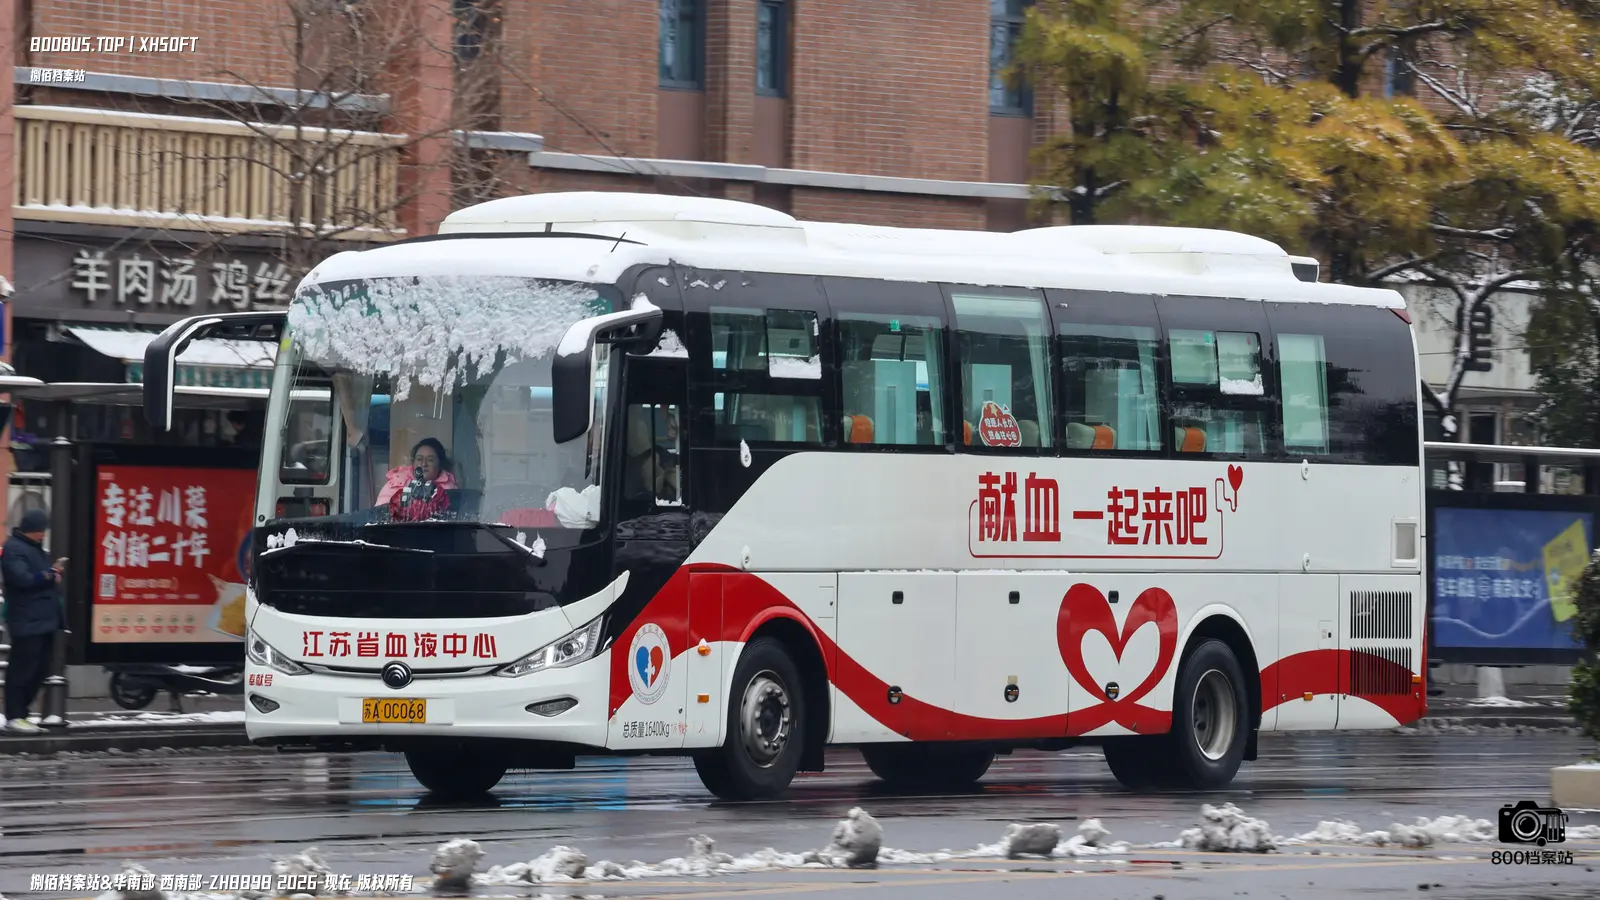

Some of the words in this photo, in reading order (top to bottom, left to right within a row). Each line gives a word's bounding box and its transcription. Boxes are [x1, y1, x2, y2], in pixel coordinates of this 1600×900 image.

[72, 249, 198, 306] 羊肉汤
[211, 259, 292, 311] 鸡丝
[102, 482, 208, 529] 专注川菜
[978, 472, 1061, 542] 献血
[1072, 486, 1208, 545] 一起来吧
[102, 531, 211, 569] 创新二十年
[302, 631, 498, 659] 江苏省血液中心
[622, 720, 670, 739] 总质量16400kg
